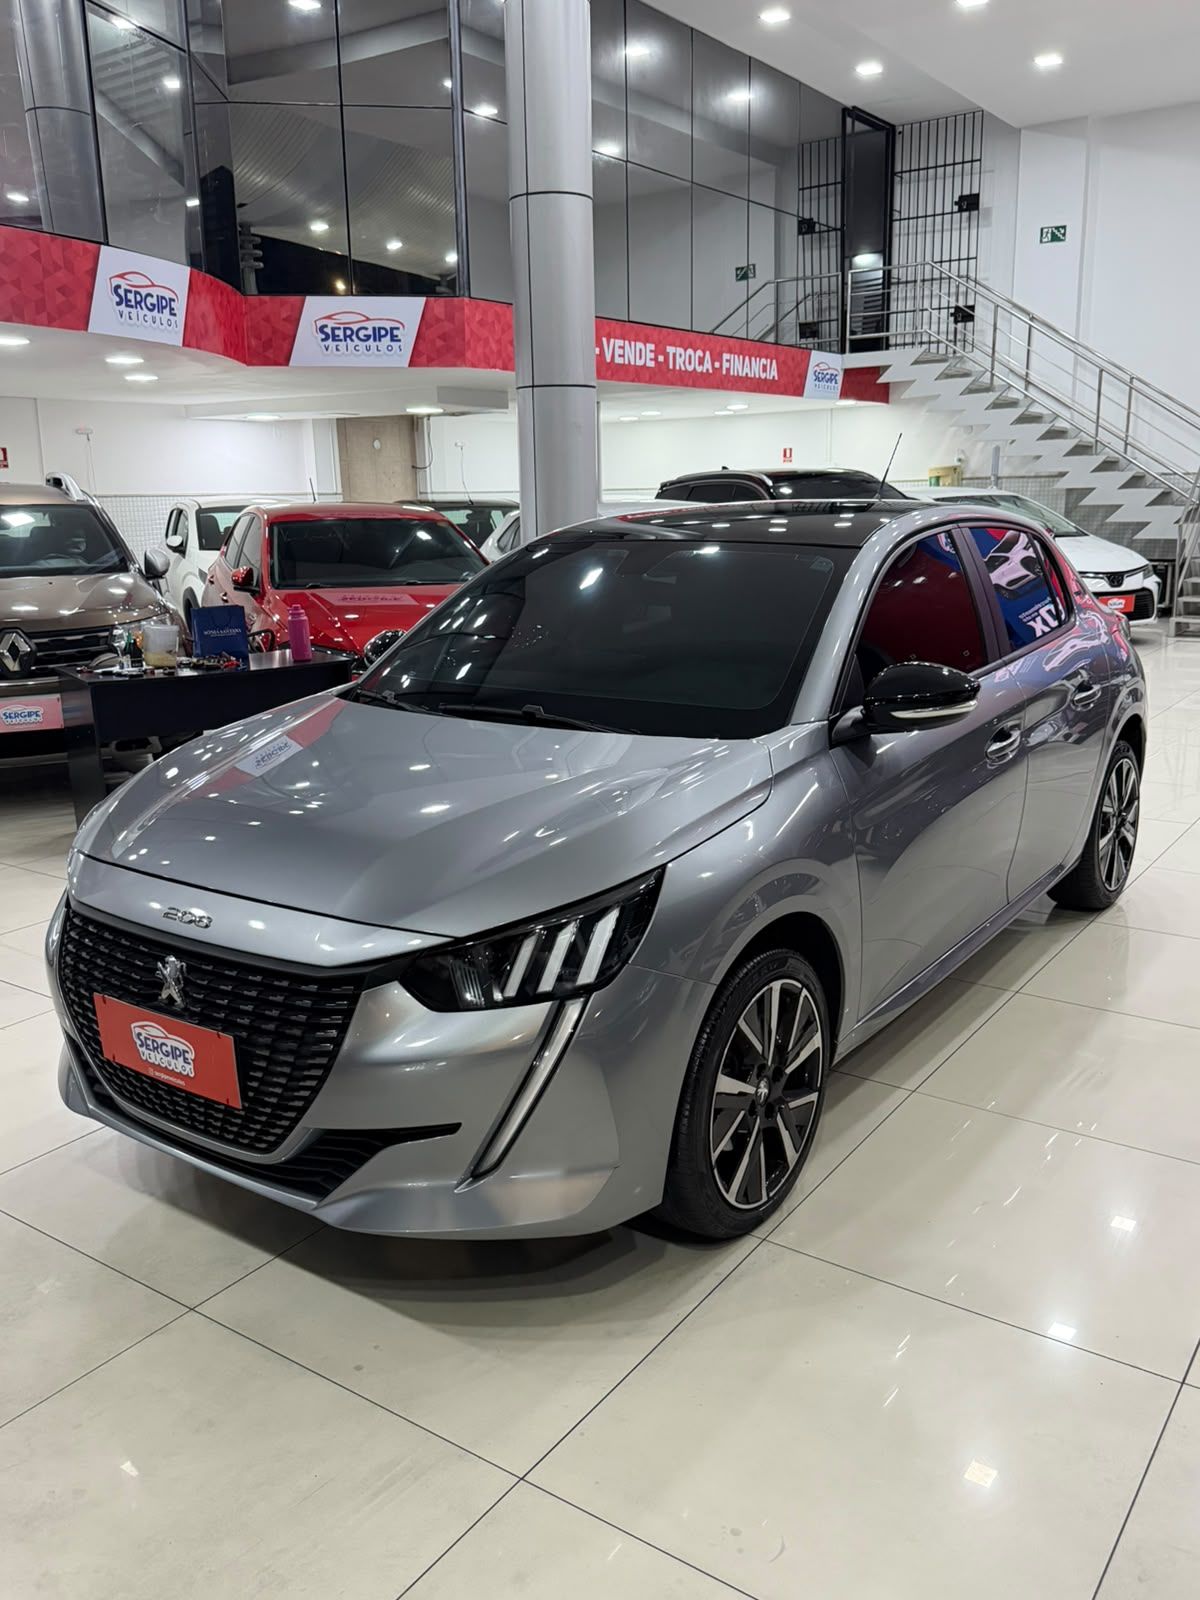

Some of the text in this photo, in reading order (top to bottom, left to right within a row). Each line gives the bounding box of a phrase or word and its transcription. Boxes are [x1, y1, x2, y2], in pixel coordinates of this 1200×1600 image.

[113, 283, 177, 317] SERGIPE
[118, 309, 178, 329] VEÍCULOS
[318, 323, 402, 343] SERGIPE
[323, 342, 402, 352] VEÍCULOS
[602, 336, 655, 368] VENDE
[666, 345, 713, 373] TROCA
[722, 352, 778, 380] FINANCIA
[813, 369, 839, 385] SERGIPE
[2, 710, 41, 720] SERGIPE
[162, 906, 213, 929] 208
[136, 1031, 191, 1066] SERGIPE
